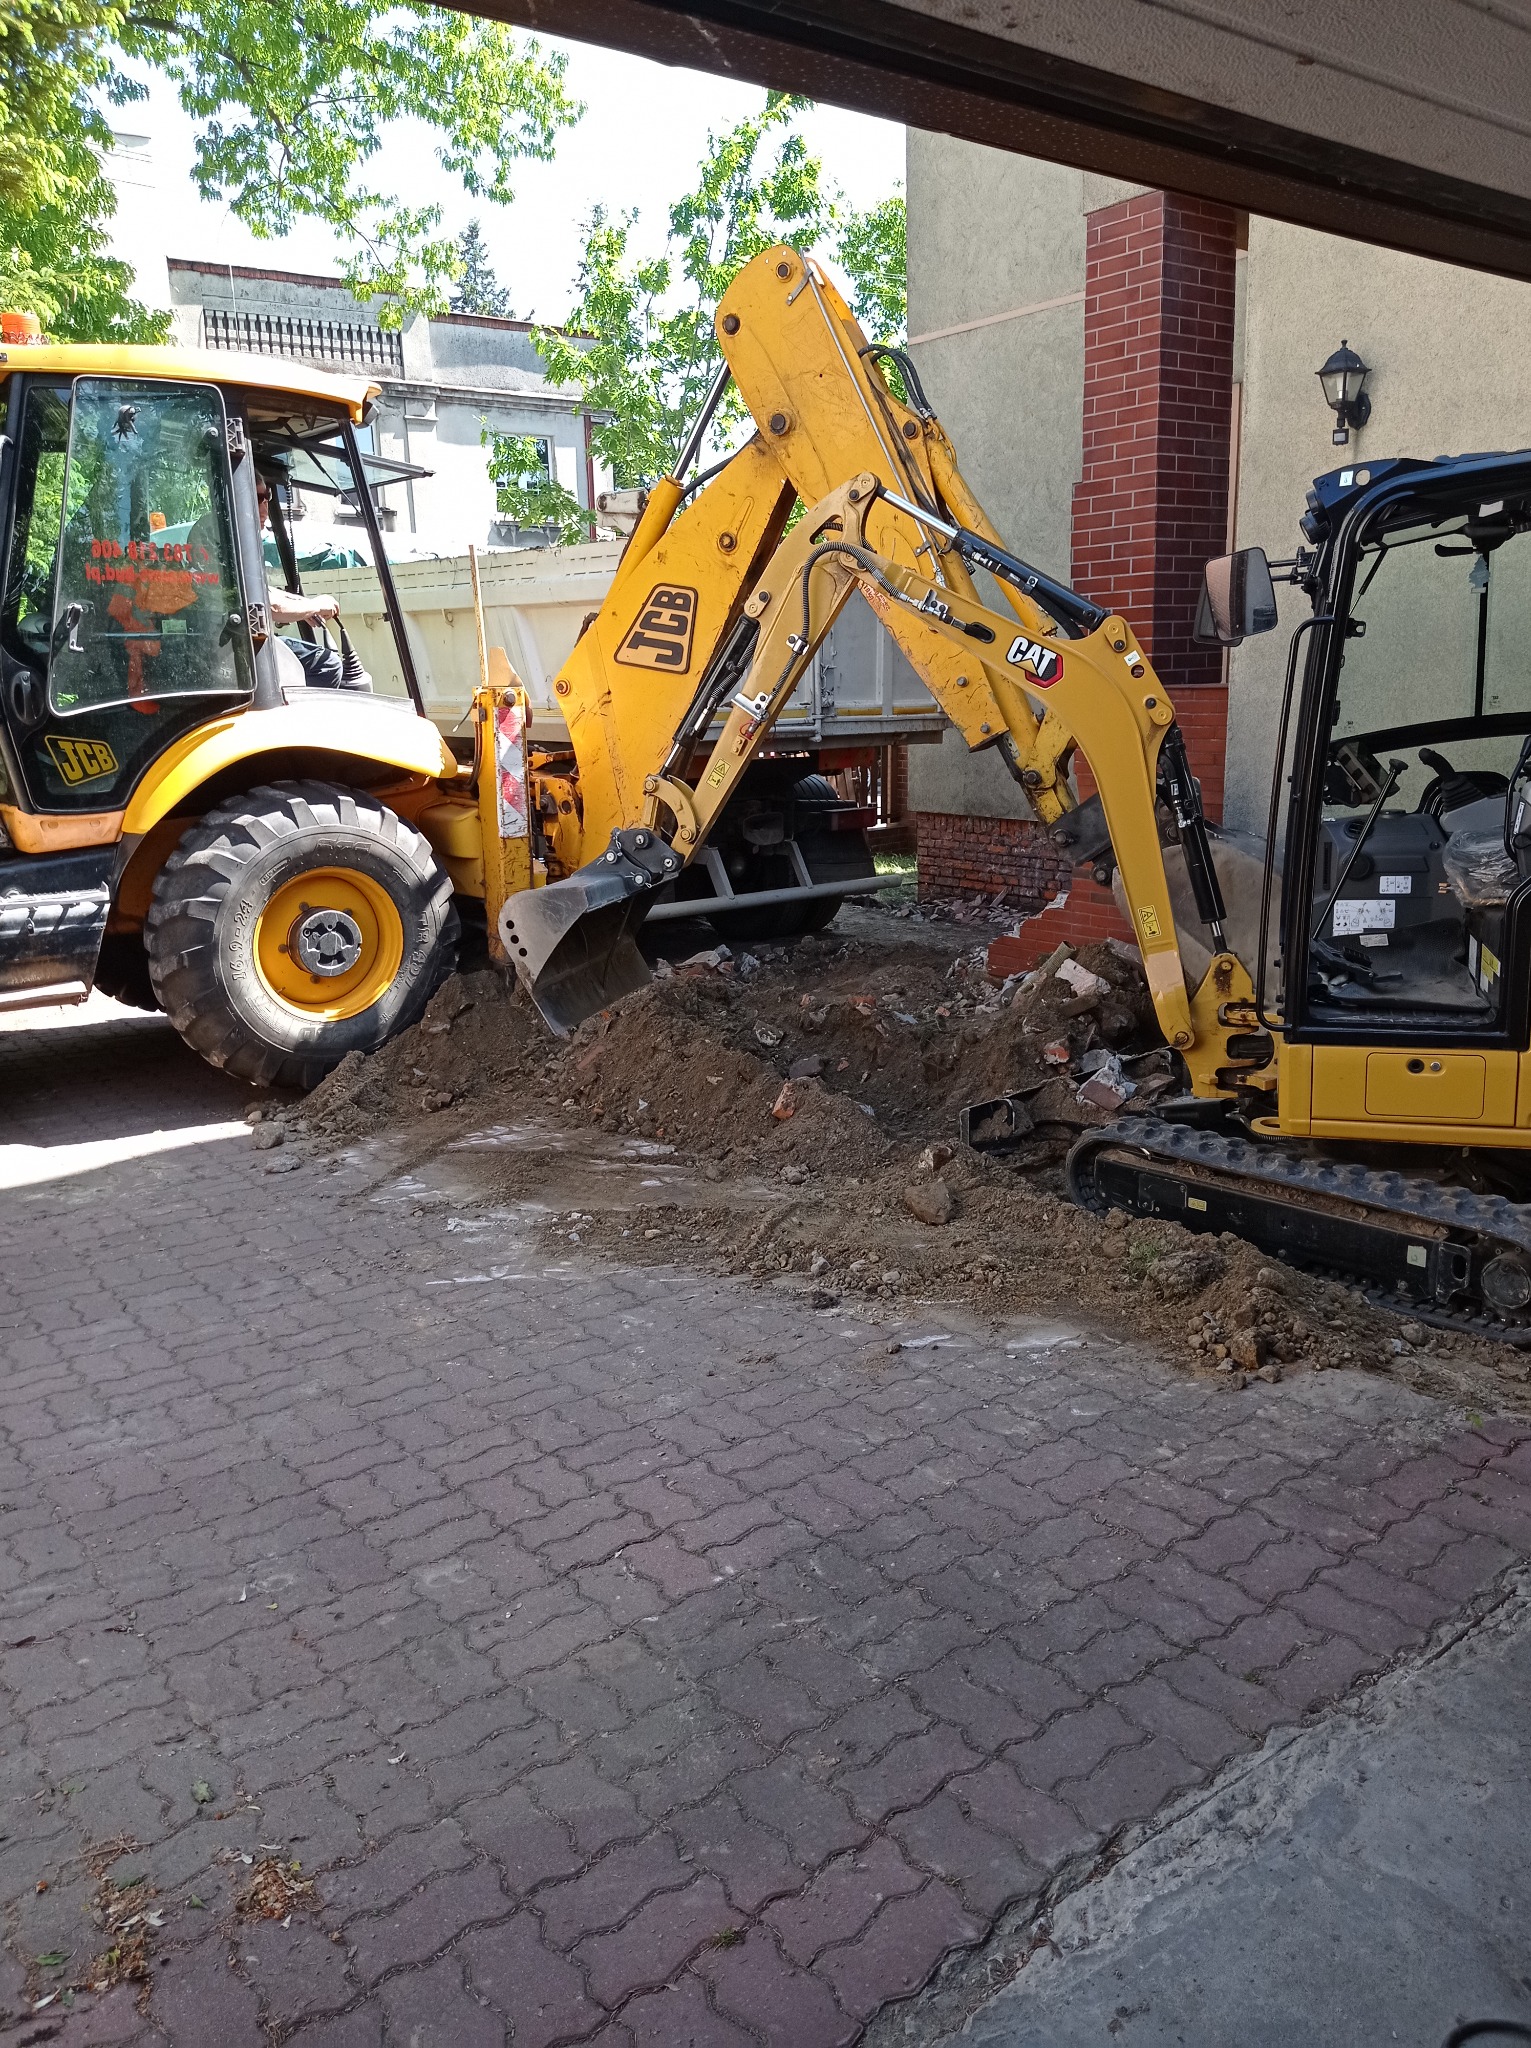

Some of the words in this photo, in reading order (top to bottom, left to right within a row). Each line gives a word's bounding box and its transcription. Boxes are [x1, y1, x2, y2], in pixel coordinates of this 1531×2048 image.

[626, 589, 692, 666] JCB
[1006, 636, 1058, 677] CAT
[56, 741, 114, 781] JCB
[228, 899, 253, 982] 16.9-24
